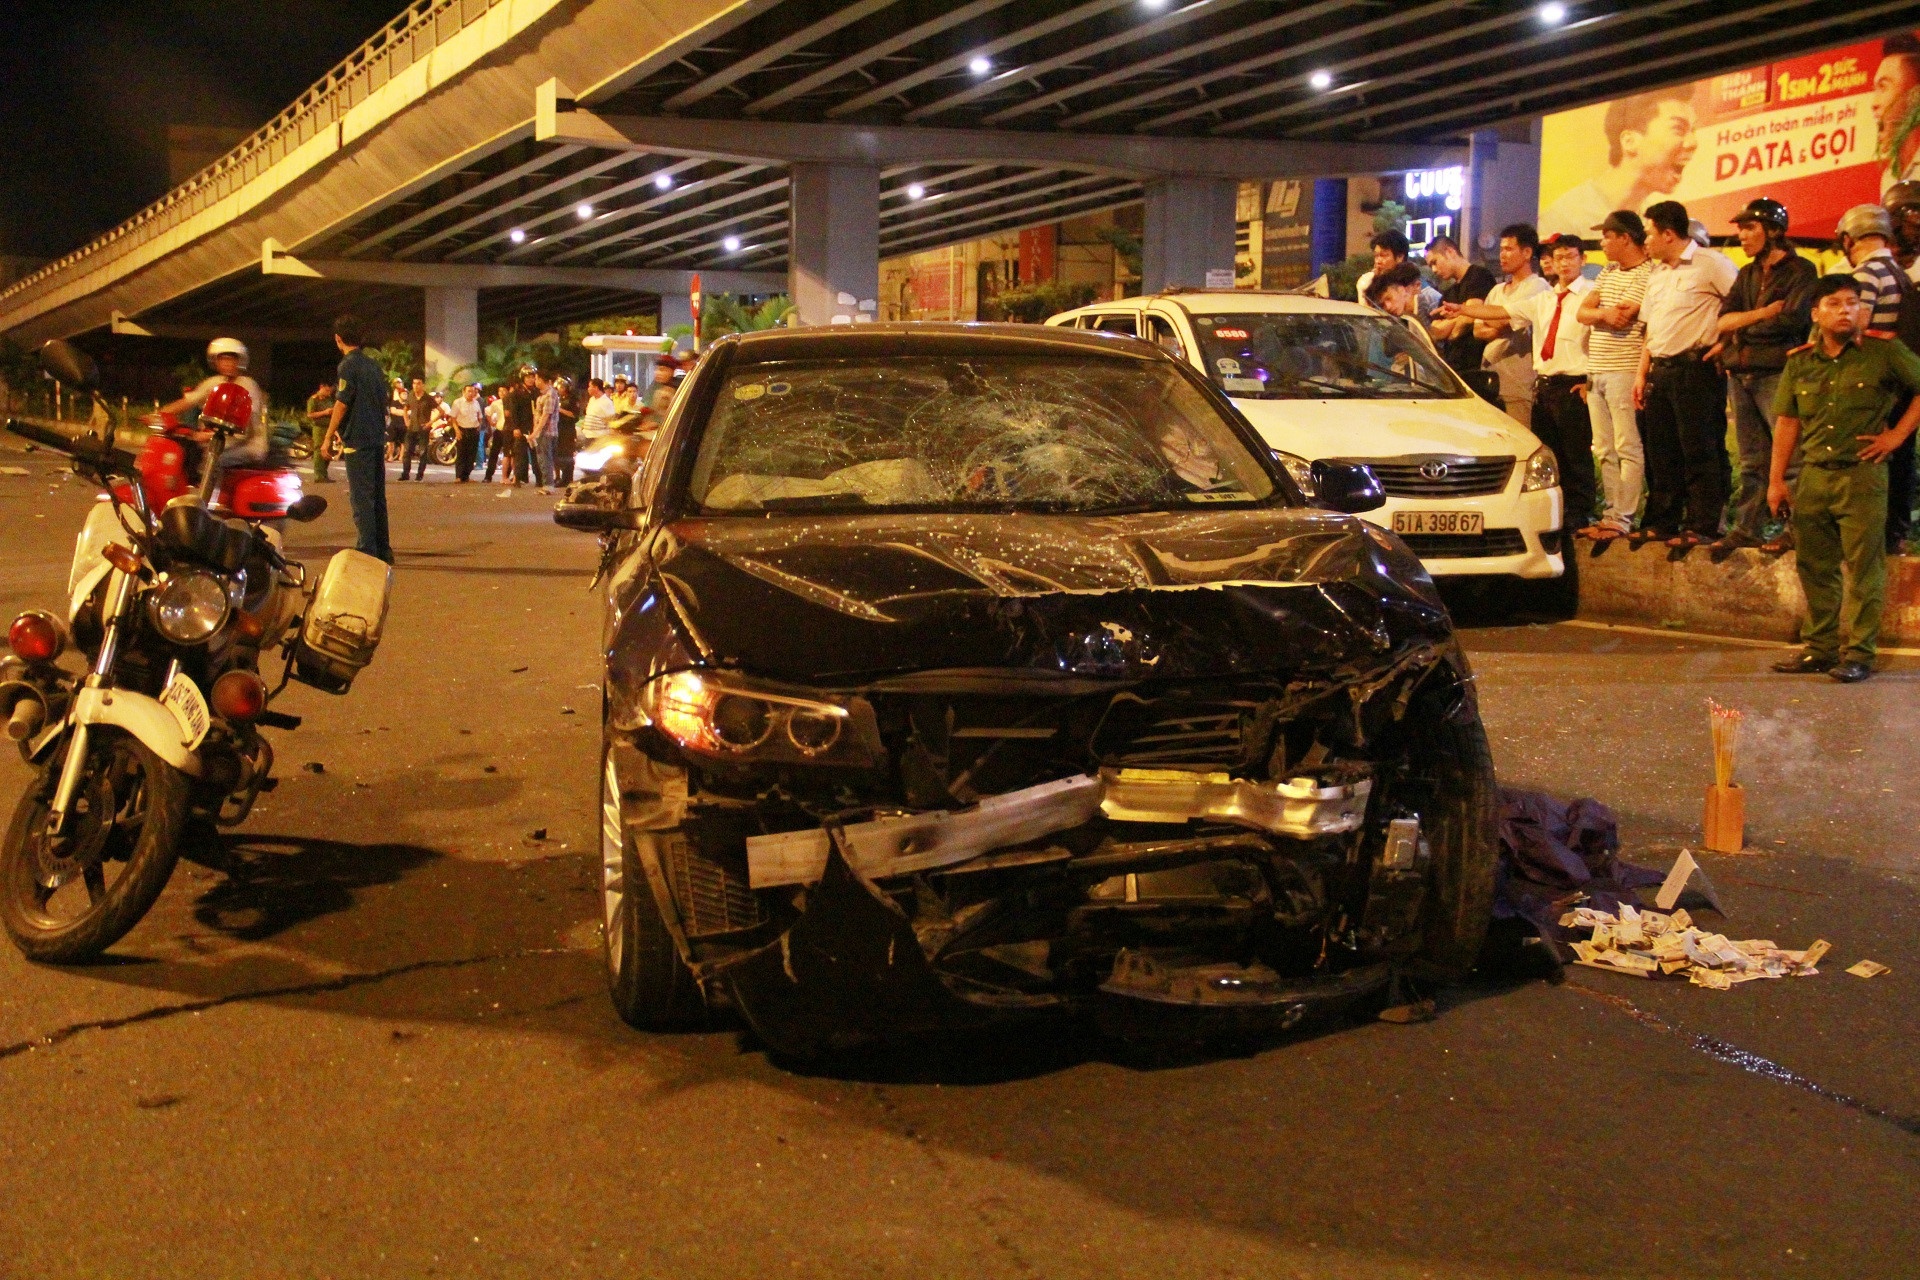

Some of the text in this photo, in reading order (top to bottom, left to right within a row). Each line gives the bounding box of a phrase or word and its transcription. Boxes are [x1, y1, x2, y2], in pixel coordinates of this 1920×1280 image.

[1717, 125, 1765, 146] Hoàn
[1770, 118, 1799, 133] toàn
[1715, 140, 1793, 182] DATA
[1811, 125, 1856, 165] GỌI
